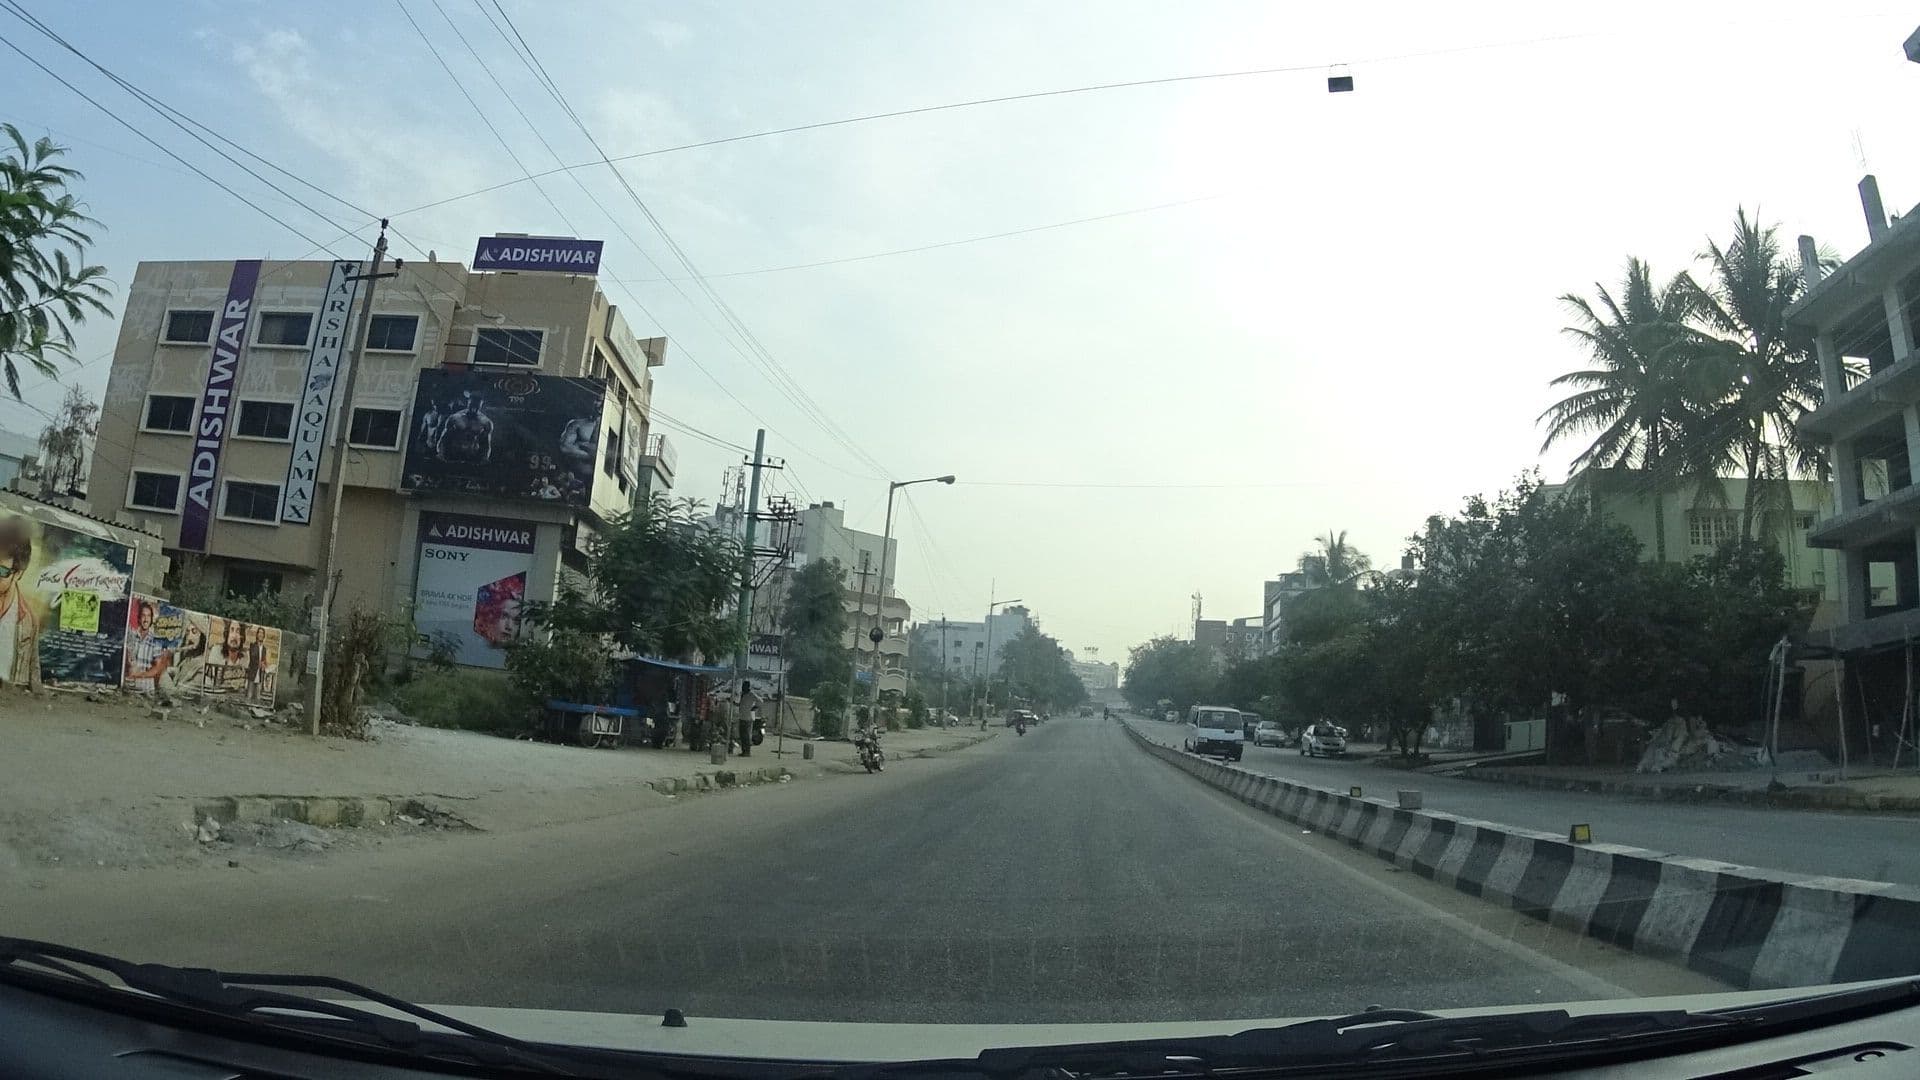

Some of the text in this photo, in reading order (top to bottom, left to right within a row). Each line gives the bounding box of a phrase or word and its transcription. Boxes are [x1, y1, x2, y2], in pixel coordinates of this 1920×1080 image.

[499, 247, 596, 264] ADISHWAR
[189, 298, 250, 510] ADISHWAR
[290, 393, 324, 520] AQUAMAX
[446, 524, 531, 545] ADISHWAR
[425, 548, 470, 562] SONY
